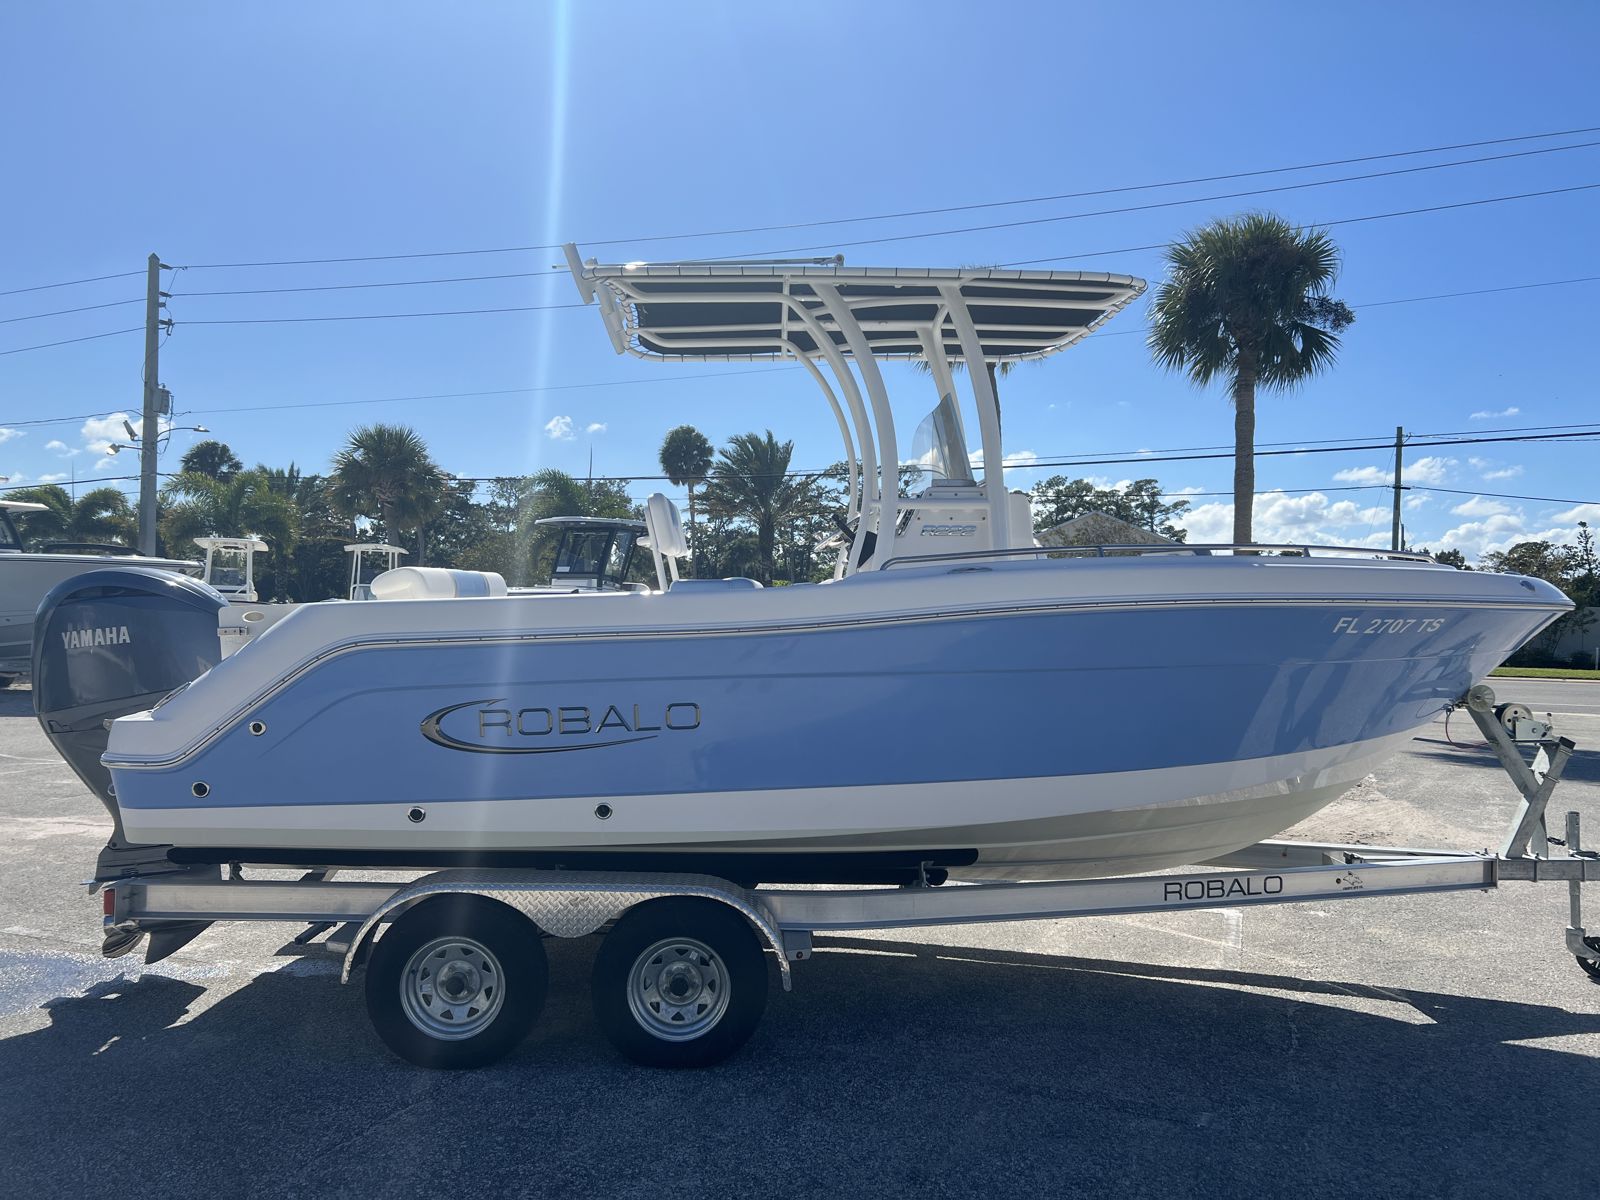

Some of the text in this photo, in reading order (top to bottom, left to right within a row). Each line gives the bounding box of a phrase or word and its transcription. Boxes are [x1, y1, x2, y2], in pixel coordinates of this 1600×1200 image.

[61, 626, 131, 649] YAMAHA
[1333, 617, 1445, 634] FL 2707 TS
[479, 702, 701, 737] ROBALO
[1164, 875, 1283, 901] ROBALO
